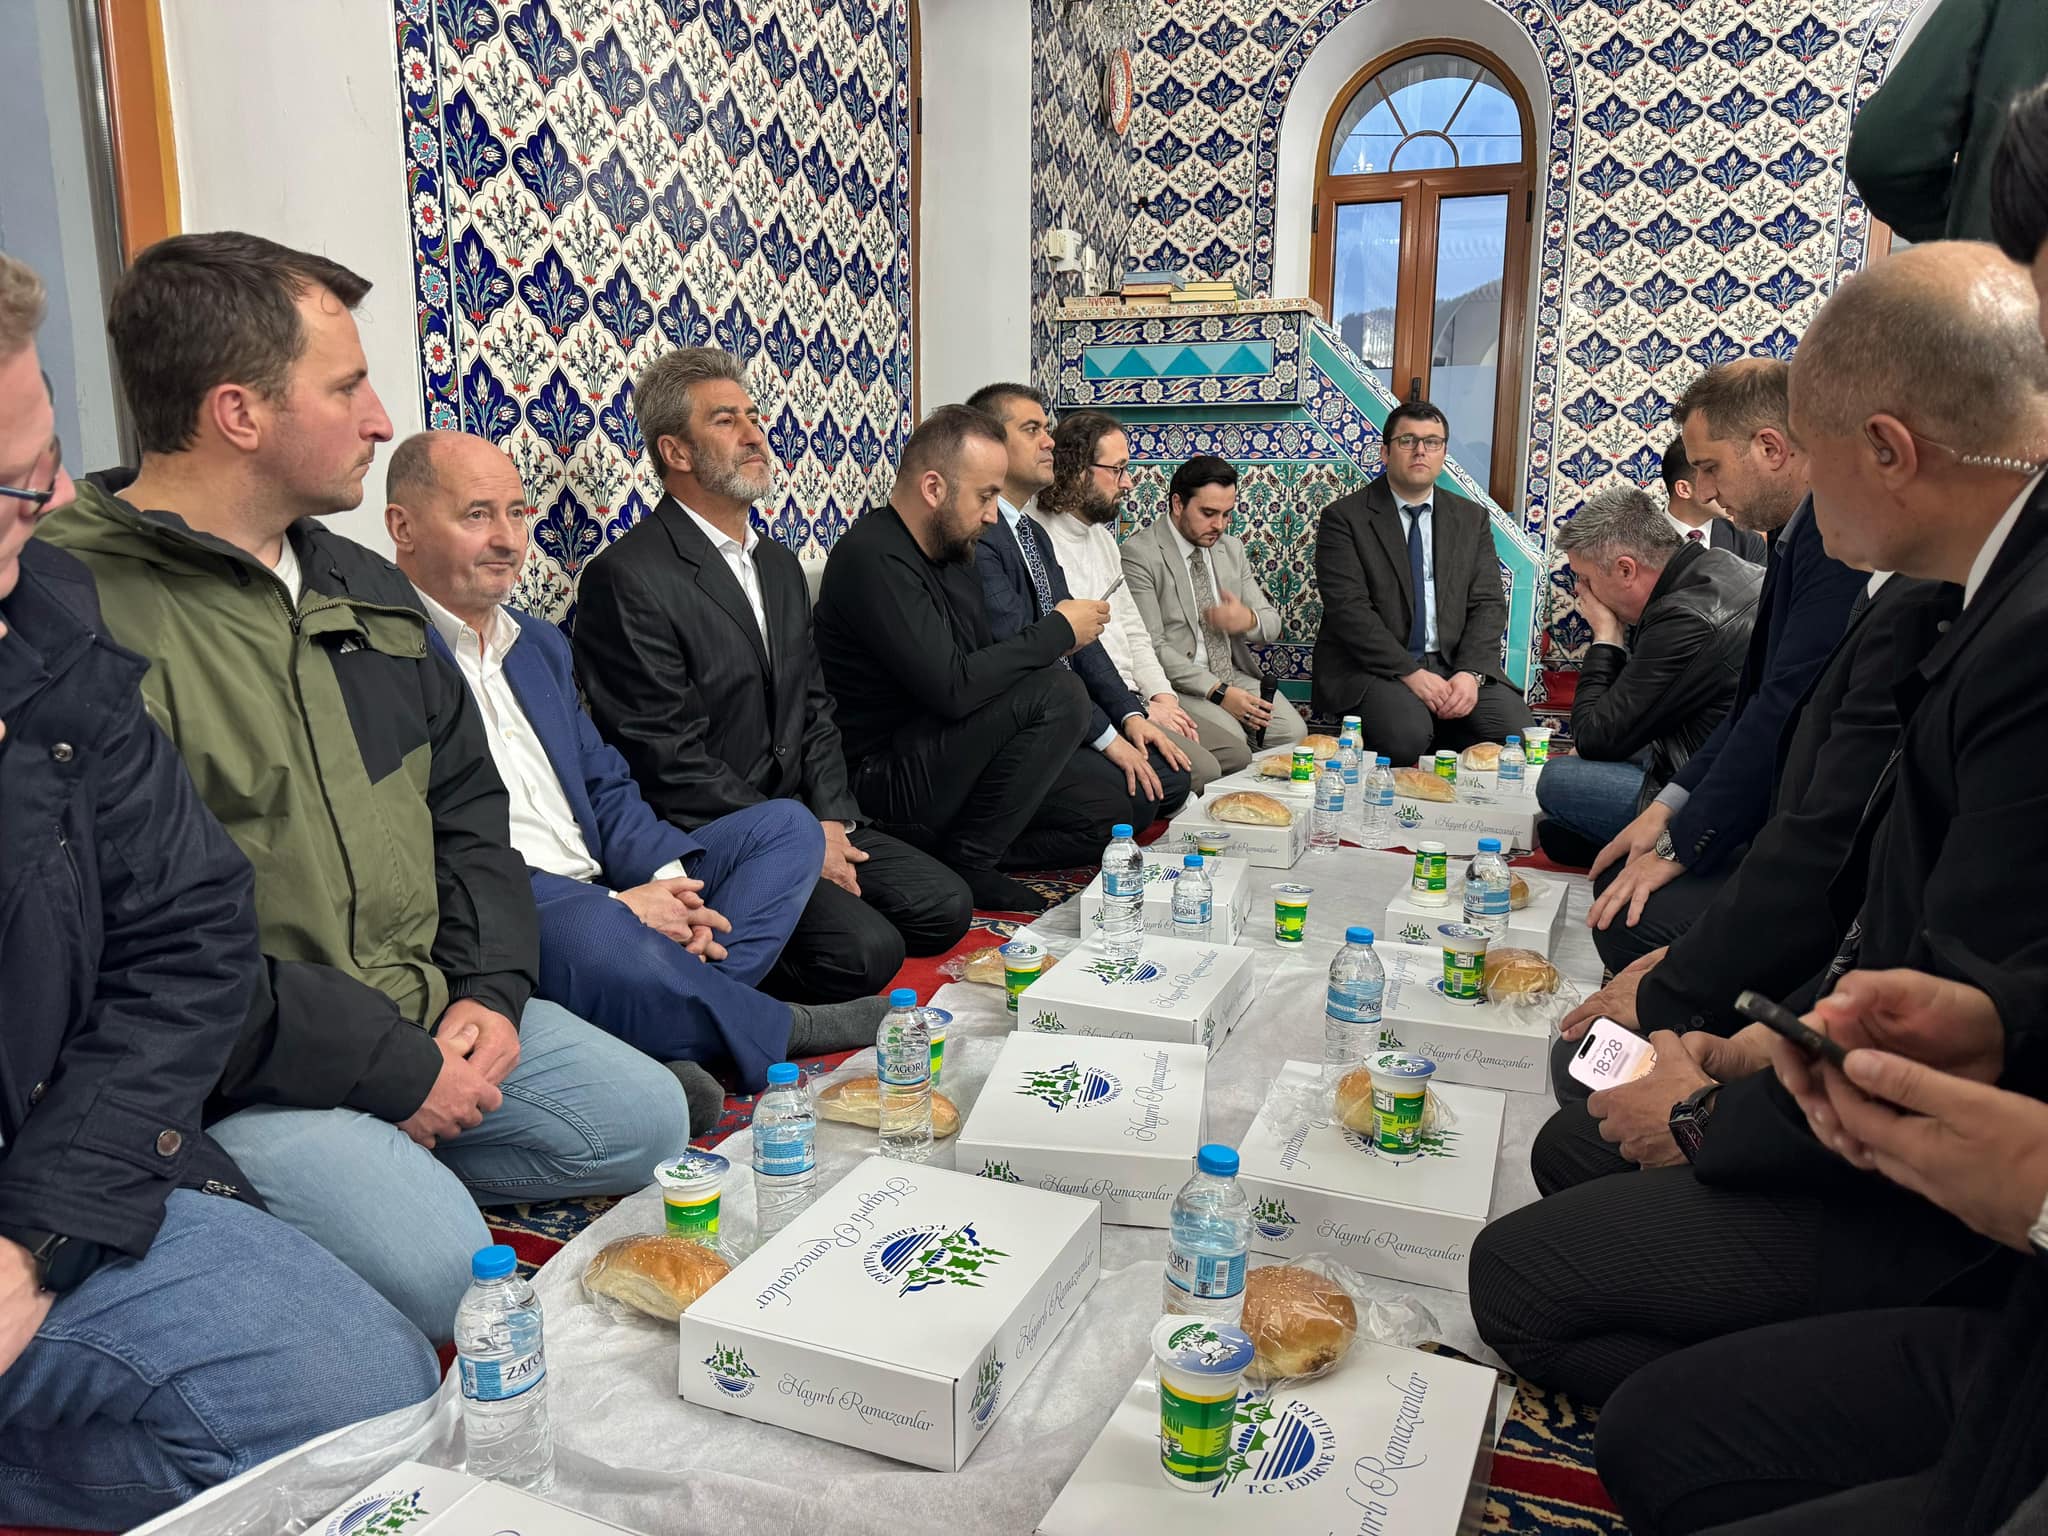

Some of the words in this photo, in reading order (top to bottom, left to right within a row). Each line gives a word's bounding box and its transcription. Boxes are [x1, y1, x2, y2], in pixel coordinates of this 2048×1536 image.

[887, 1061, 924, 1074] ZAGORI
[1134, 1050, 1177, 1102] Ramazanlar
[1419, 1042, 1461, 1062] Hayırlı
[1463, 1049, 1533, 1069] Ramazanlar
[1592, 1039, 1623, 1077] 18:28
[1123, 1099, 1169, 1142] Hayırlı
[849, 1176, 918, 1230] Hayırlı
[1040, 1174, 1088, 1195] Hayırlı
[1091, 1179, 1173, 1204] Ramazanlar
[1317, 1218, 1376, 1247] Hayırlı
[1374, 1231, 1465, 1263] Ramazanlar
[755, 1223, 861, 1310] Ramazanlar
[778, 1373, 838, 1407] Hayırlı
[839, 1391, 934, 1432] Ramazanlar
[1287, 1400, 1337, 1450] VALİLİĞİ
[1355, 1371, 1429, 1496] Ramazanlar
[1245, 1483, 1283, 1495] T.C.
[1285, 1452, 1336, 1491] EDİRNE
